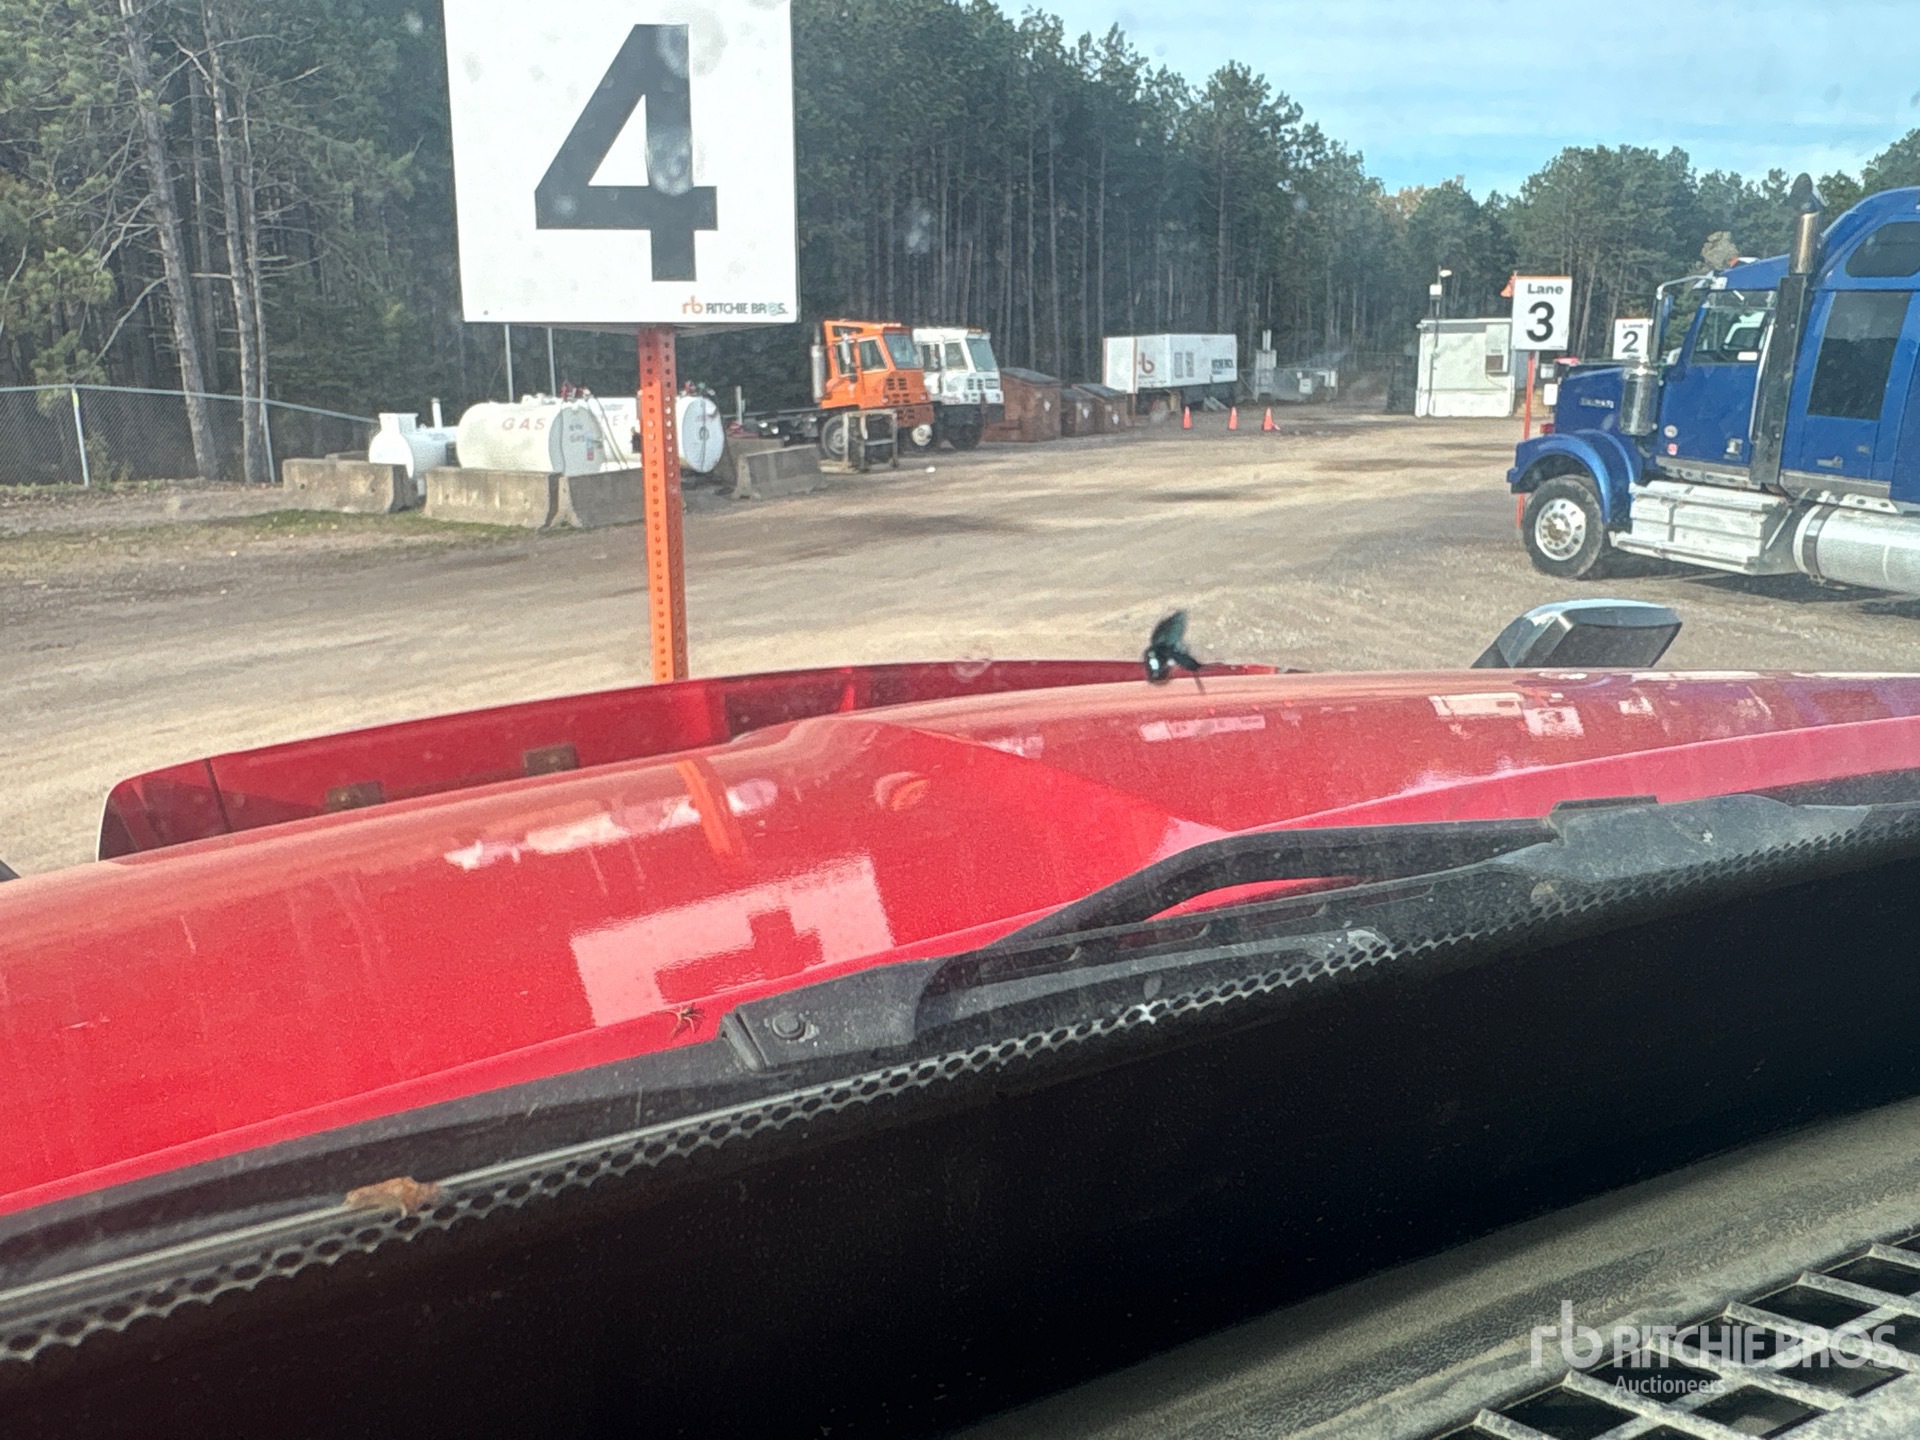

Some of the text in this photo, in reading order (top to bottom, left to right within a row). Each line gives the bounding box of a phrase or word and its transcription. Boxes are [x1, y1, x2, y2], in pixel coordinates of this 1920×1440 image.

[534, 24, 718, 282] 4
[1527, 283, 1564, 295] Lane
[705, 303, 748, 314] RITCHIE
[1526, 301, 1555, 342] 3
[1621, 330, 1639, 353] 2
[501, 417, 546, 431] GAS
